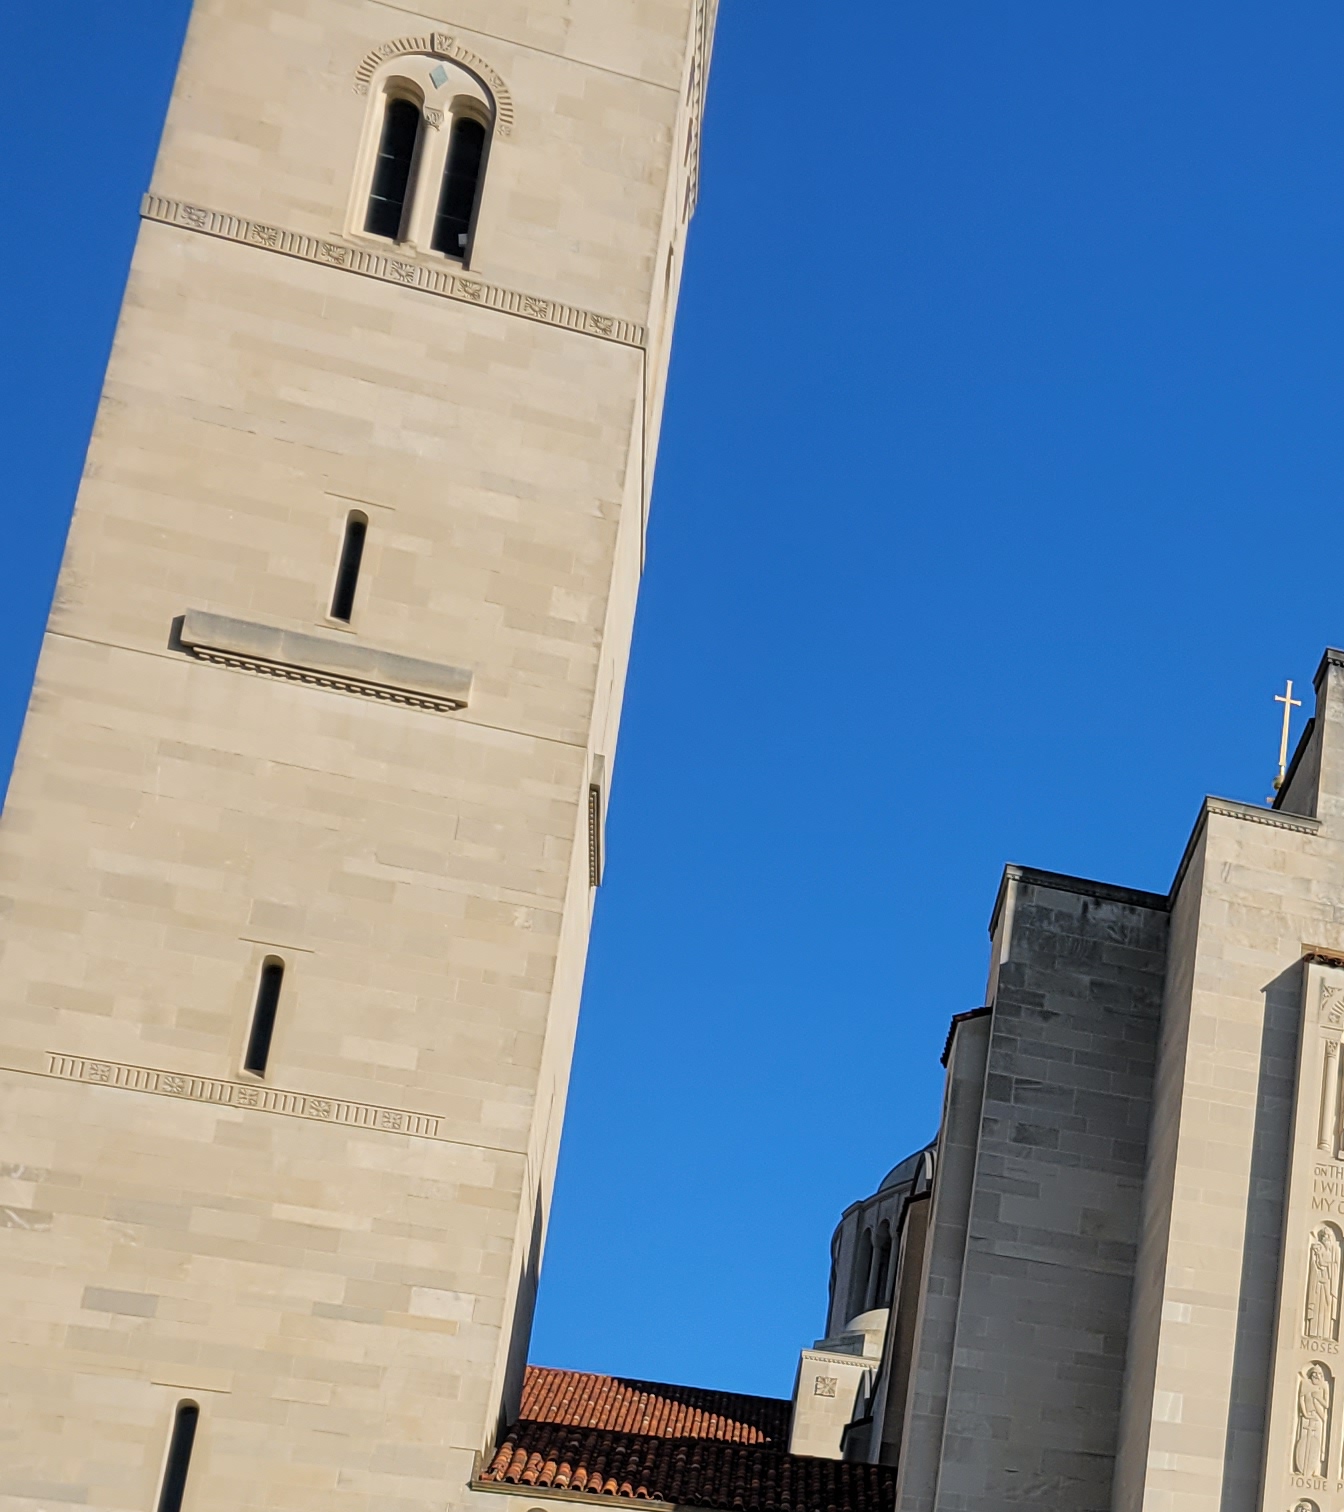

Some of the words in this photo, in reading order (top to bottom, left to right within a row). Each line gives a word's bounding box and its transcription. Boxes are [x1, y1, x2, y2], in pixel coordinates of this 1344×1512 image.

[1312, 1196, 1335, 1212] MY
[1300, 1340, 1339, 1354] MOSES
[1290, 1477, 1327, 1491] JOSUE
